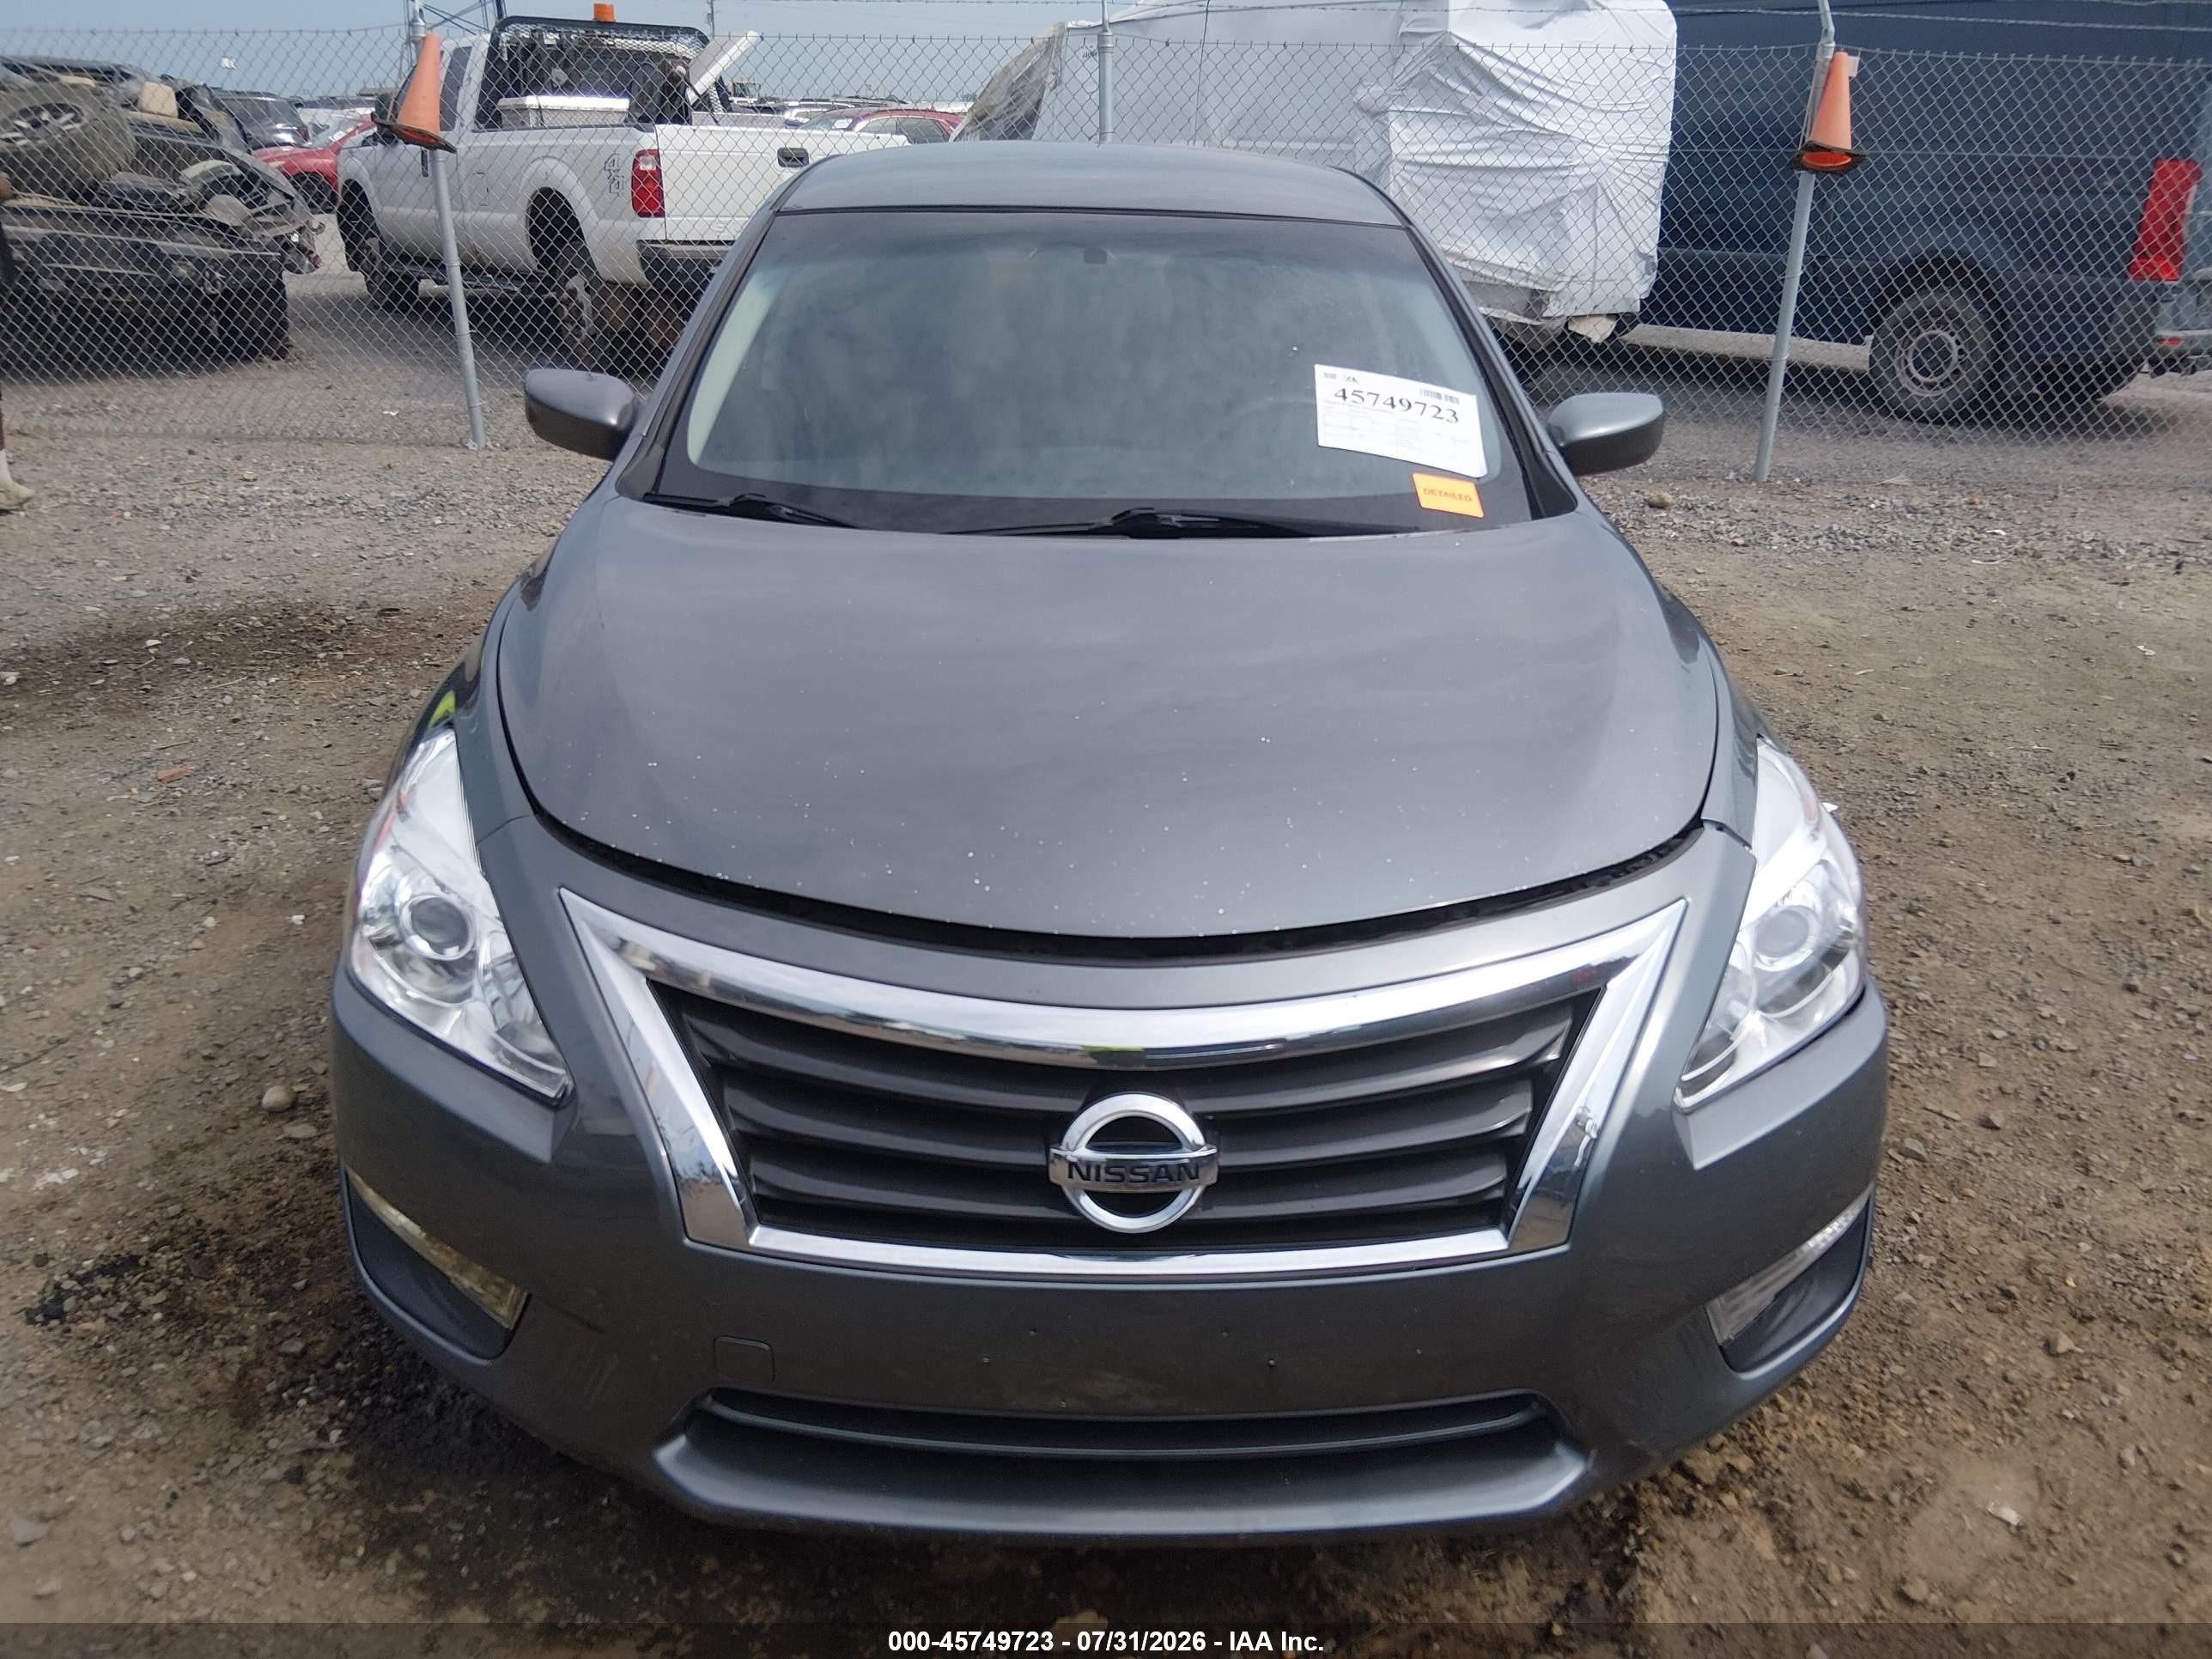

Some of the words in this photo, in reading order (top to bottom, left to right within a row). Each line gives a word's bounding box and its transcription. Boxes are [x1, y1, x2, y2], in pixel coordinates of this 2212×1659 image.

[1334, 387, 1459, 424] 45749723
[1423, 488, 1473, 502] DETAILED
[1066, 1163, 1200, 1183] NISSAN
